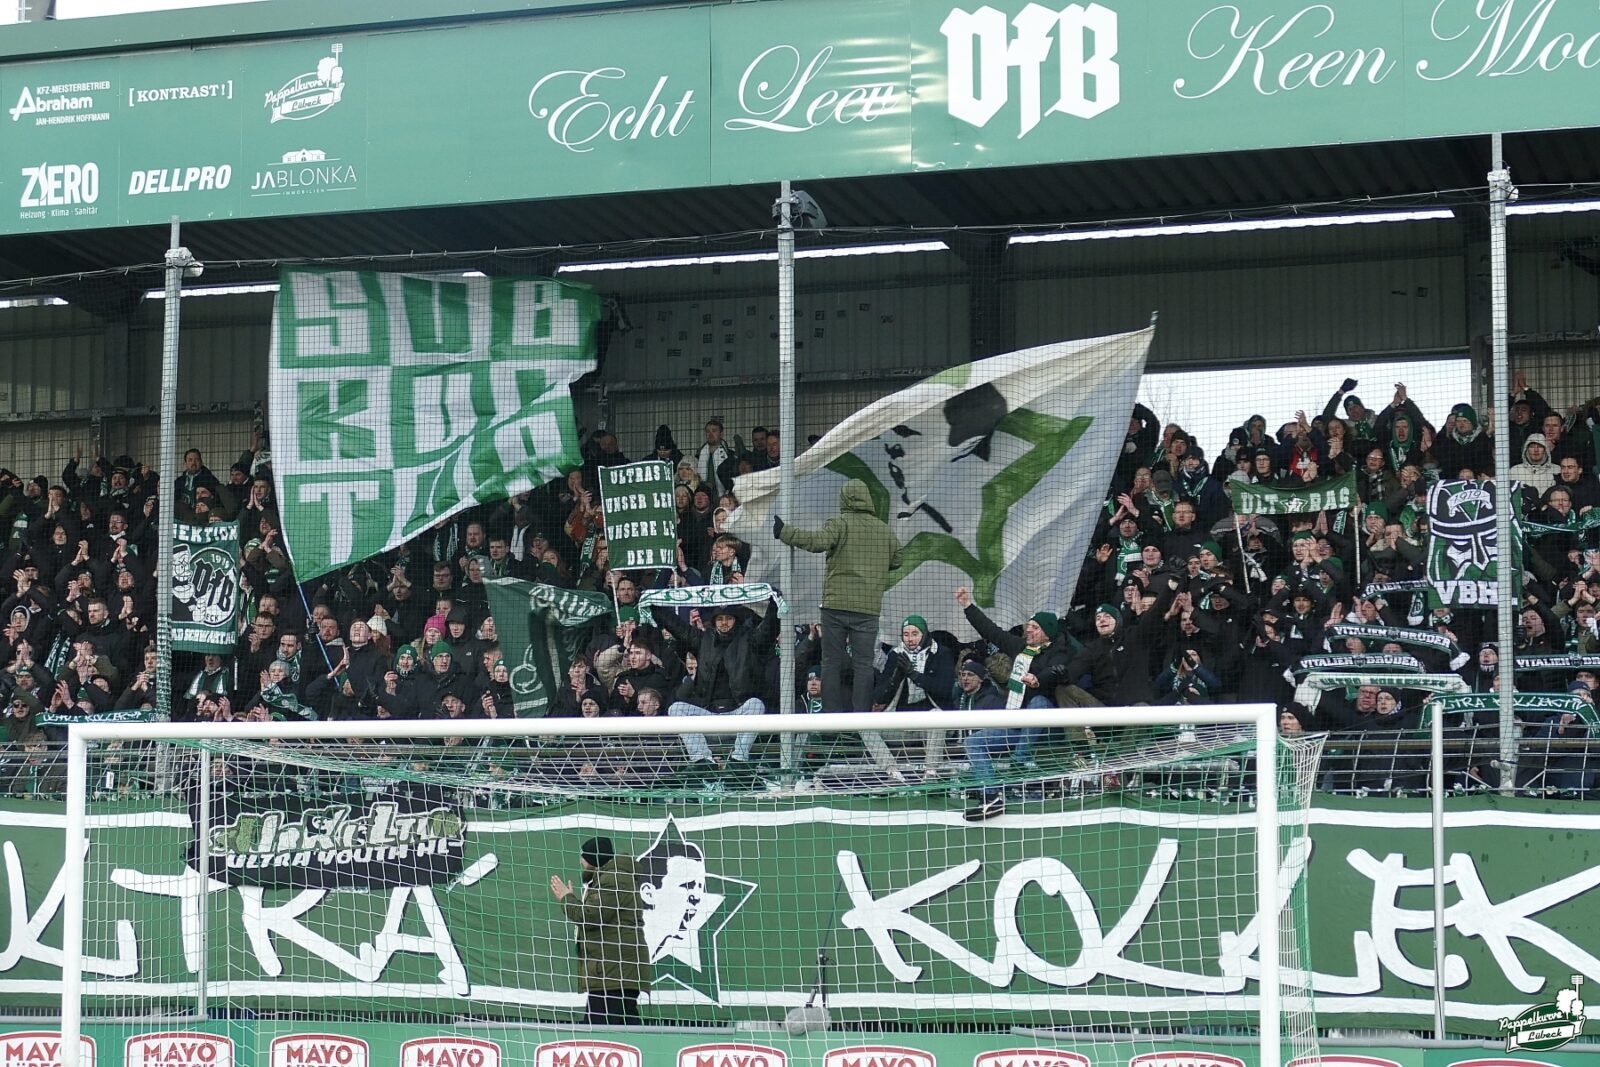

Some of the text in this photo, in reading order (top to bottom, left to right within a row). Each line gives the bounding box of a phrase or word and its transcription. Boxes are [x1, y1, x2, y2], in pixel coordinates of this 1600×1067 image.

[1173, 5, 1396, 99] Keen
[939, 3, 1120, 140] VfB
[36, 81, 110, 95] KFZ-MEISTERBETRIEB
[264, 78, 325, 108] Pappelkurve
[9, 86, 93, 121] Abraham
[291, 96, 322, 111] Lübeck
[529, 67, 695, 153] Echt
[35, 112, 110, 126] JAN-HENDRIK HOFFMANN
[128, 164, 232, 195] DELLPRO
[251, 165, 357, 190] JABLONKA
[20, 205, 98, 220] Heizung Klima Sanitär
[292, 271, 580, 356] SUB
[610, 465, 660, 485] ULTRAS
[605, 493, 647, 513] UNSER
[607, 521, 657, 541] UNSERE
[627, 549, 654, 566] DER
[1434, 580, 1518, 606] VBH
[1334, 626, 1450, 648] VITALIEN BRÜDER
[1300, 654, 1419, 669] VITALIEN BRÜDER
[1516, 657, 1570, 668] VITALIEN
[5, 1042, 61, 1061] MAY
[143, 1042, 216, 1062] MAYO
[286, 1043, 353, 1064] MAYO
[417, 1047, 484, 1067] MAYO
[552, 1051, 624, 1067] MAYO
